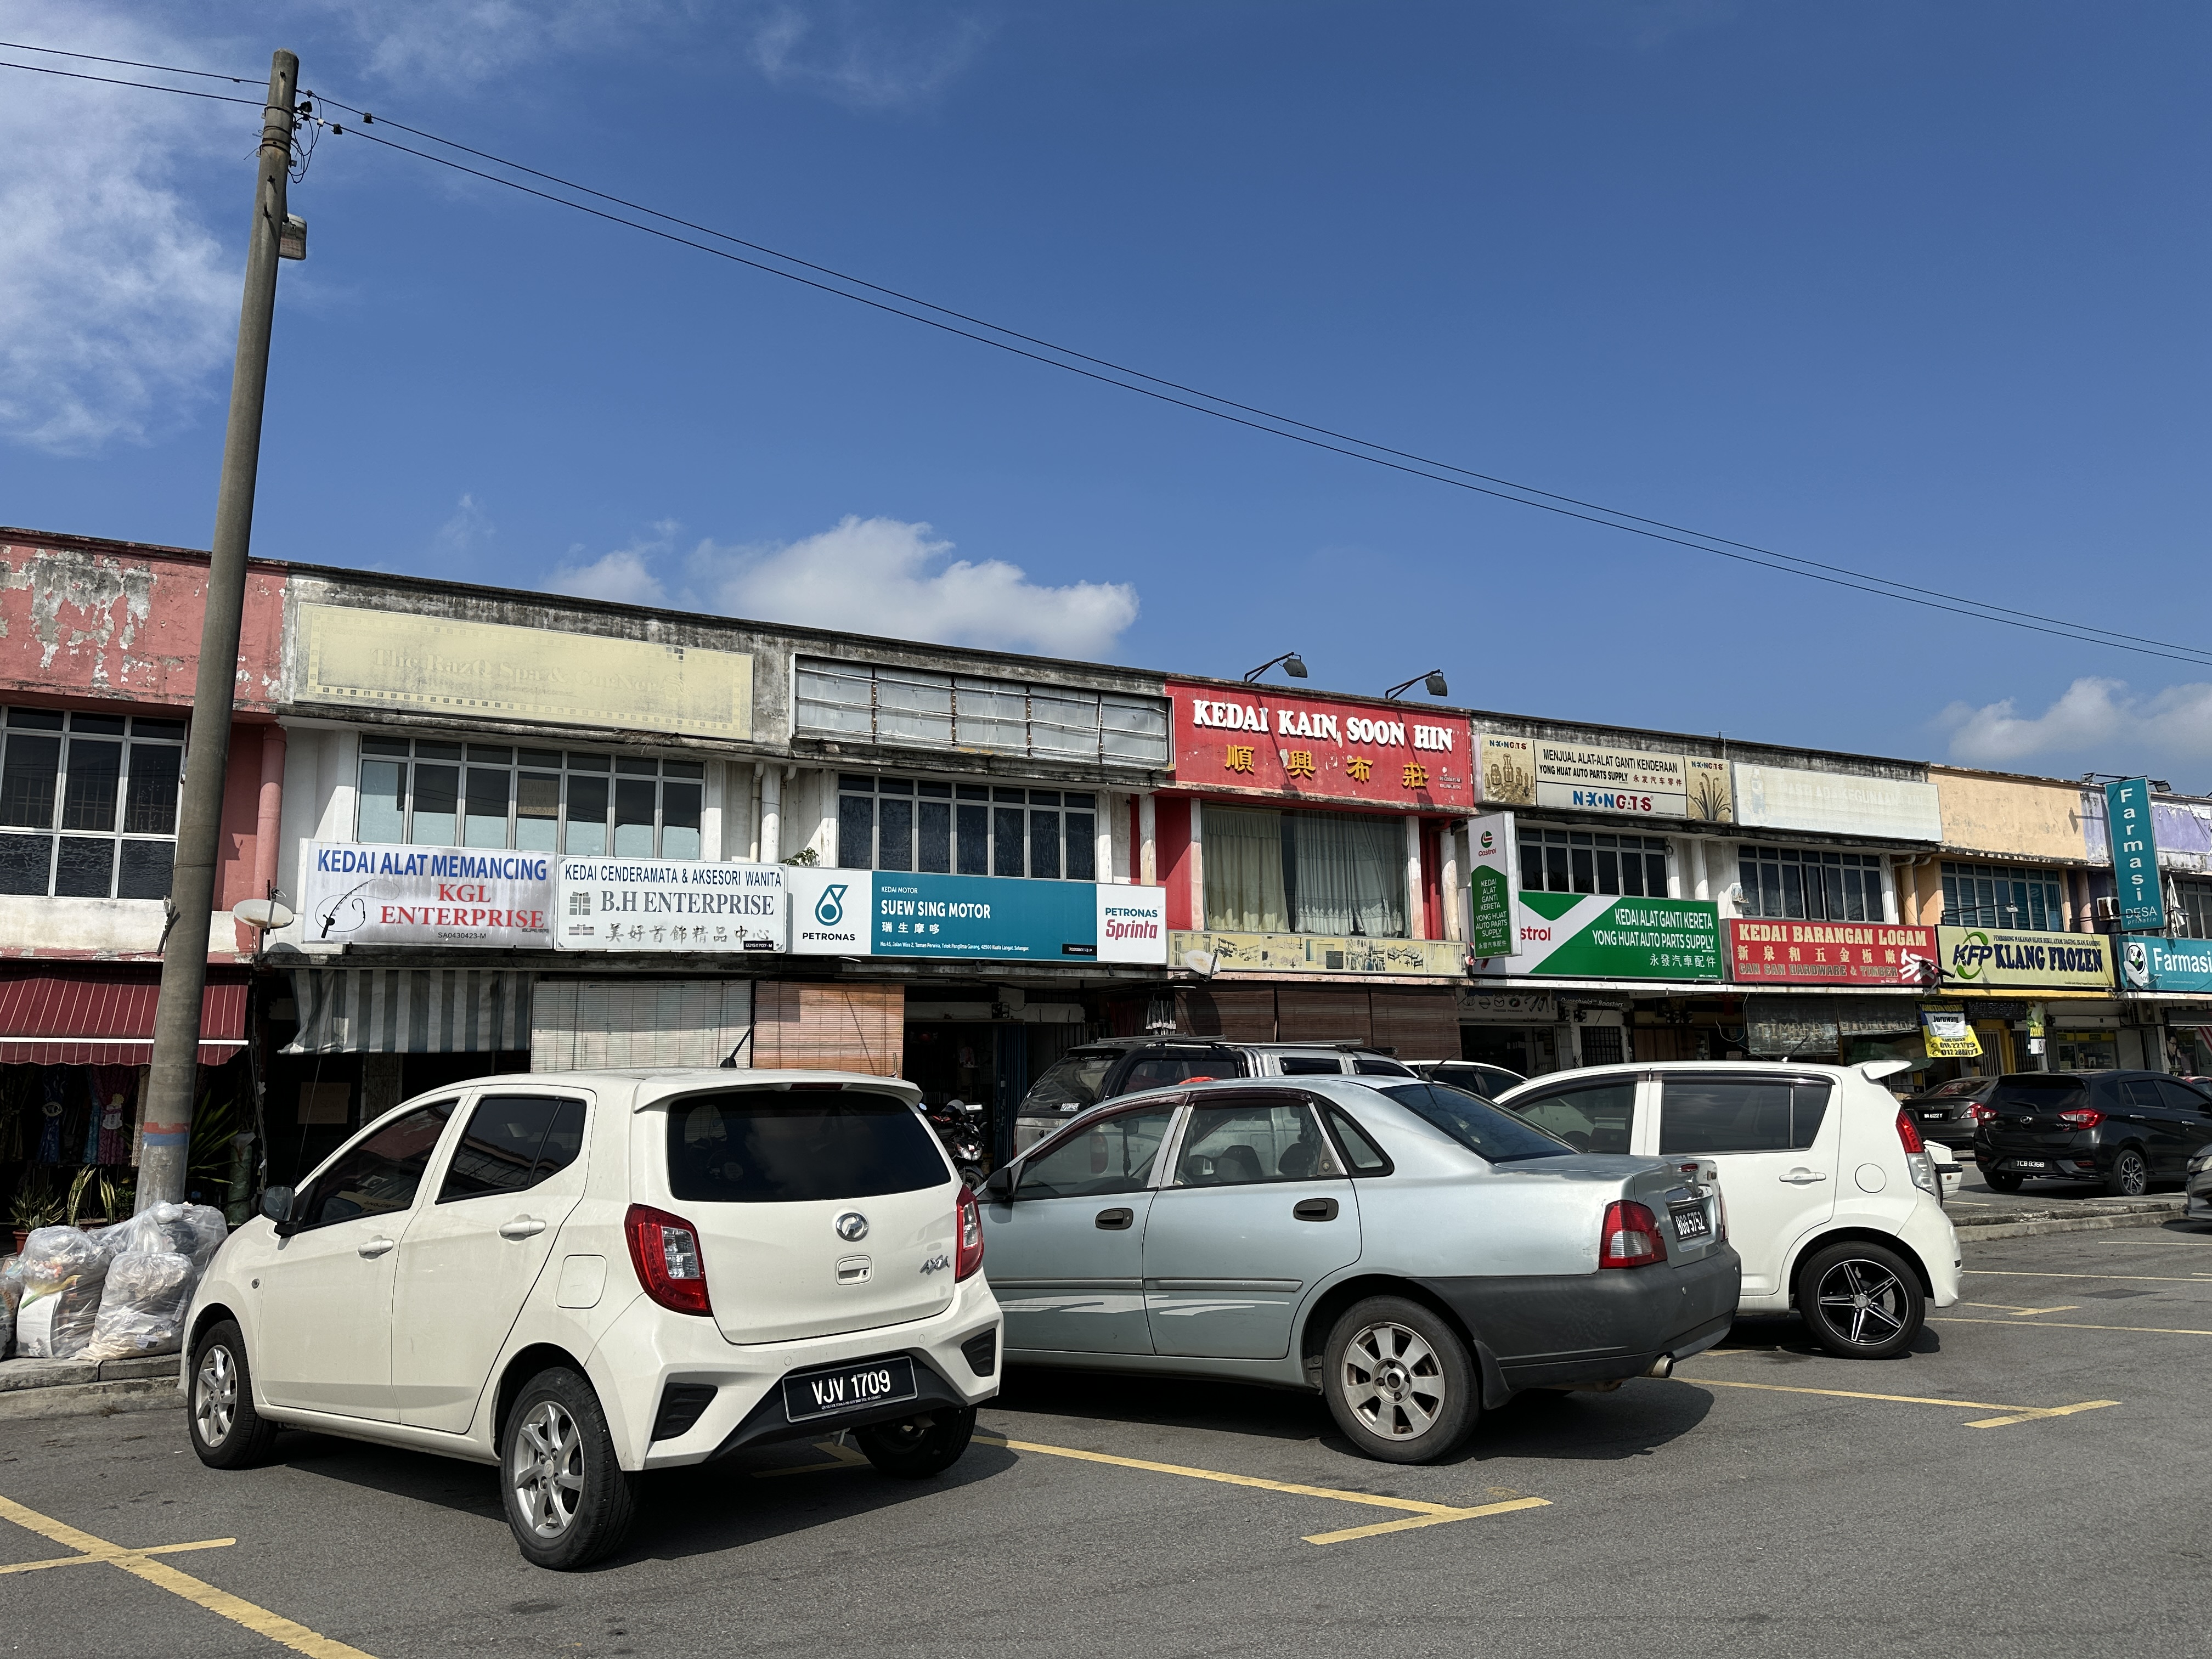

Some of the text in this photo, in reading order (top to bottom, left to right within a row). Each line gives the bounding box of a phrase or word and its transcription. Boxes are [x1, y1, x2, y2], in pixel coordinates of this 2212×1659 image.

[1193, 699, 1454, 752] KEDAI KAIN SOON HIN
[1224, 744, 1429, 788] 順興布莊
[1543, 749, 1678, 774] MENJUAL ALAT-ALAT GANTI KENDERAAN
[1539, 764, 1628, 782] YONG HUAT AUTO PARTS SUPPLY
[1478, 847, 1497, 857] Castrol
[2120, 788, 2144, 901] Farmasi
[318, 849, 546, 881] KEDAI ALAT MEMANCING
[565, 864, 782, 887] KEDAI CENDERAMATA & AKSESORI WANITA
[1481, 878, 1497, 888] KEDAI
[438, 883, 492, 903] KGL
[1481, 895, 1498, 904] GANTI
[1483, 887, 1496, 895] ALAT
[601, 890, 775, 916] B.H ENTERPRISE
[881, 899, 991, 919] SUEW SING MOTOR
[1105, 908, 1158, 918] PETRONAS
[1480, 902, 1501, 911] KERETA
[2125, 906, 2158, 919] DESA
[380, 906, 544, 928] ENTERPRISE
[1476, 911, 1506, 922] YONG HUAT
[1476, 919, 1508, 930] AUTO PARTS
[1615, 909, 1713, 930] KEDAI ALAT GANTI KERETA
[605, 922, 770, 944] 美好首飾精品中心
[803, 933, 855, 941] PETRONAS
[882, 922, 940, 934] 瑞生摩哆
[1105, 919, 1158, 941] Sprinta
[1482, 928, 1502, 937] SUPPLY
[1520, 927, 1551, 941] strol
[1739, 923, 1927, 946] KEDAI BARANGAN LOGAM
[1592, 930, 1714, 950] YONG HUAT AUTO PARTS SUPPLY
[1649, 953, 1716, 968] 永發汽車配件
[1953, 944, 1993, 966] KFP
[1994, 944, 2103, 972] KLANG FROZEN
[2153, 947, 2212, 974] Farmasi
[1739, 962, 1899, 977] GAN SAN HARDWARE & TIMBER
[1598, 1000, 1624, 1008] Boosters
[1686, 1211, 1705, 1232] 5752
[919, 1255, 950, 1275] AXIA
[811, 1376, 843, 1405] VJV
[851, 1369, 891, 1398] 1709
